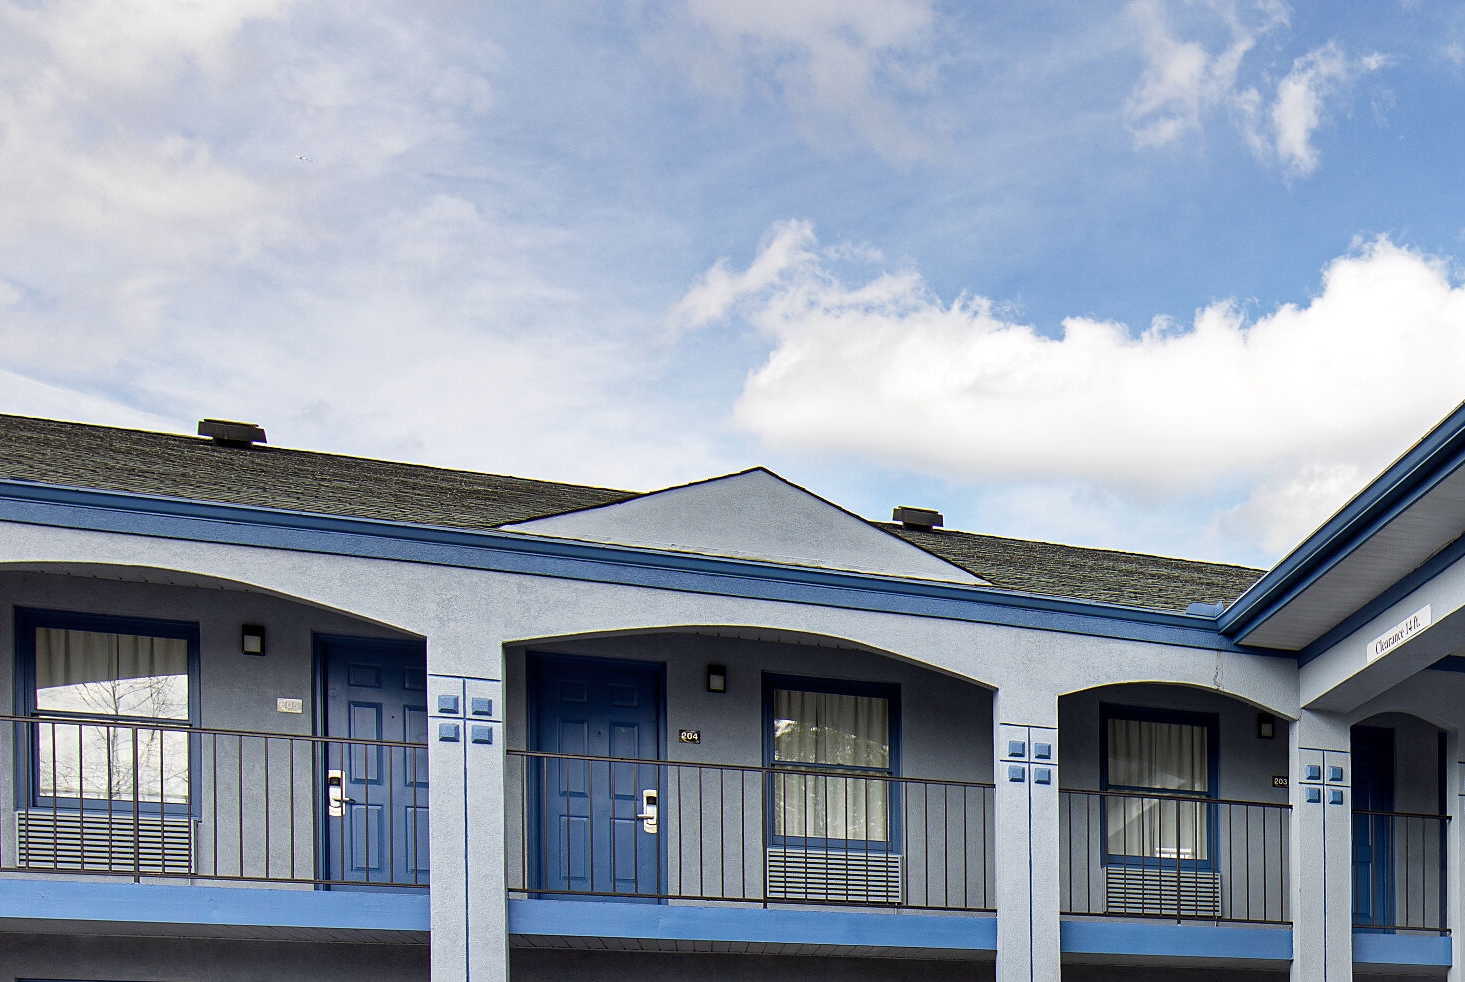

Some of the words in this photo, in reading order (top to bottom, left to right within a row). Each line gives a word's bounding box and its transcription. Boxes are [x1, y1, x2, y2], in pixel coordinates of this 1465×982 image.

[1375, 629, 1405, 655] Clearance
[1405, 619, 1413, 635] 14
[1413, 615, 1421, 630] ft.
[681, 731, 699, 741] 204
[1273, 777, 1288, 786] 203
